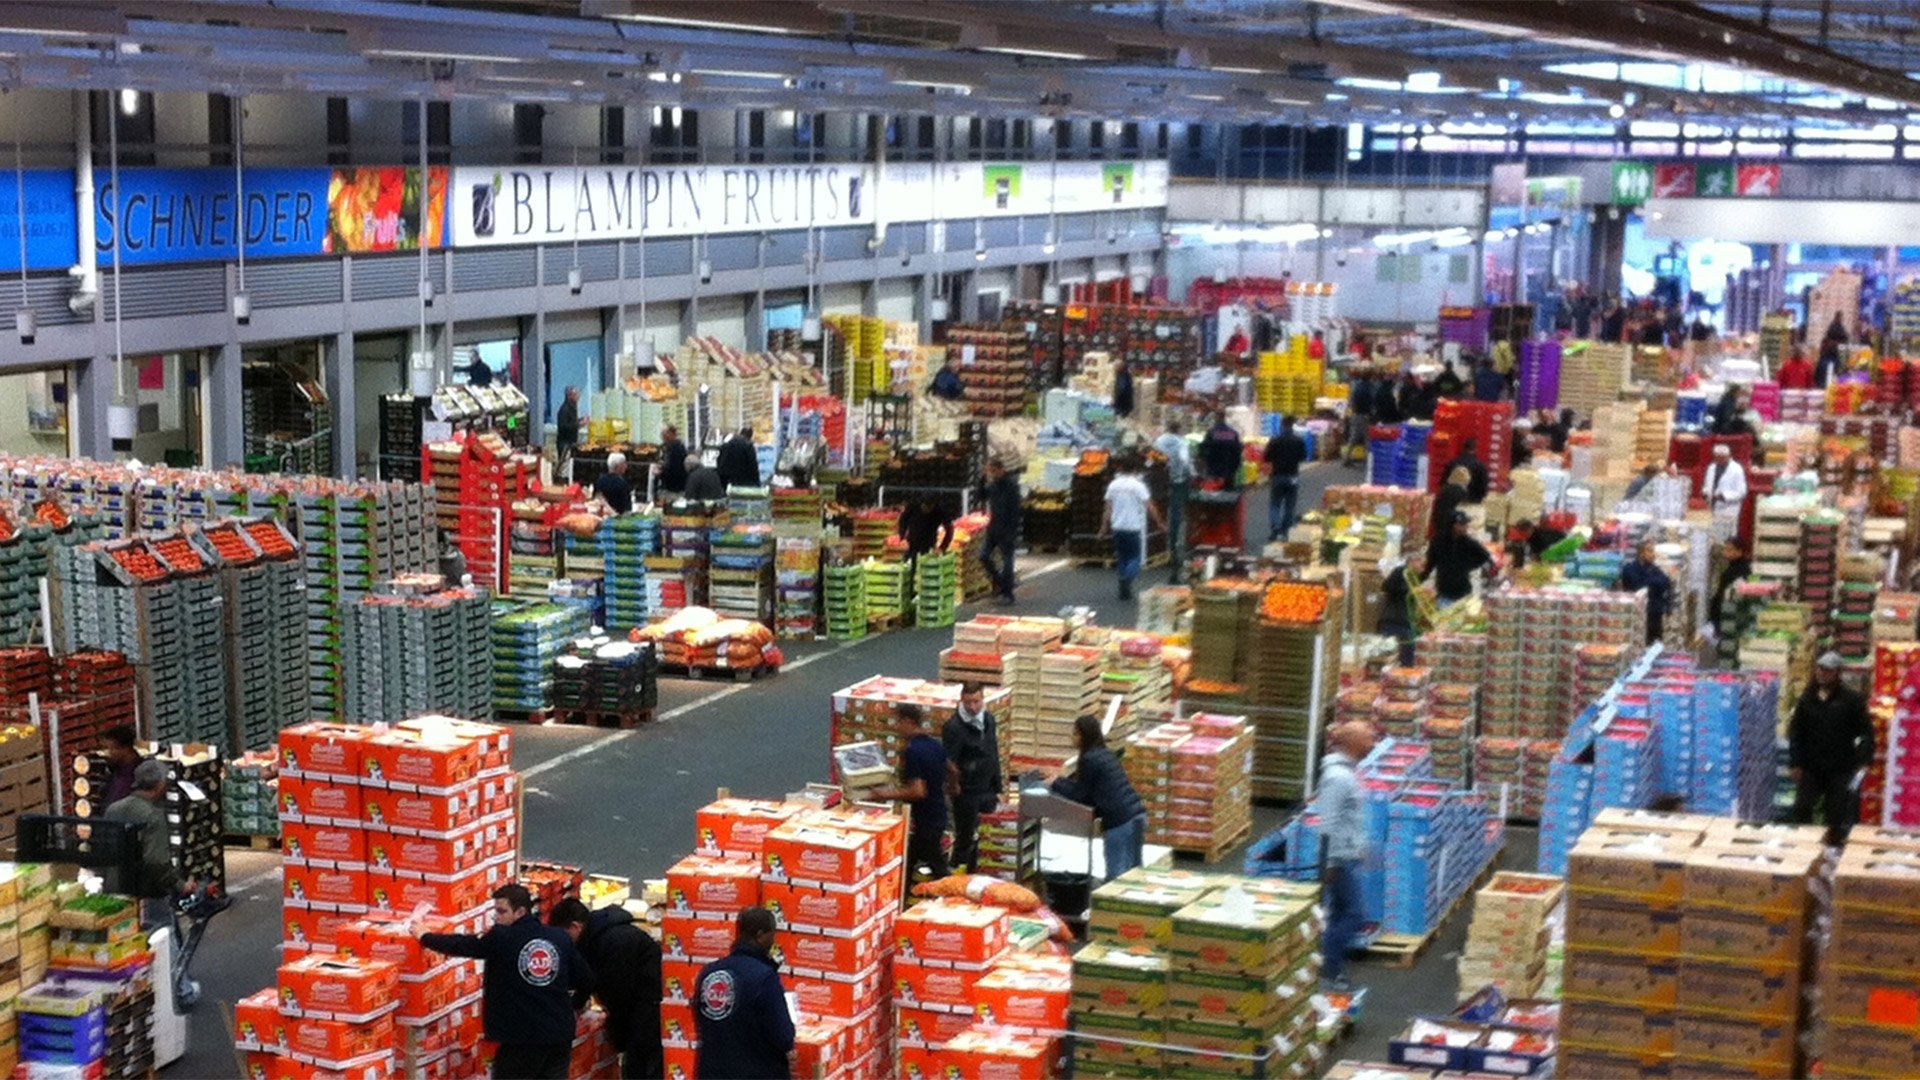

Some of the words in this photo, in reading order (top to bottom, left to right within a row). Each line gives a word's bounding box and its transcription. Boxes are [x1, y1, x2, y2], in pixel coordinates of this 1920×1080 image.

[96, 183, 313, 251] SCHNEIDER
[512, 170, 705, 236] BLAMPIN
[723, 166, 840, 227] FRUITS
